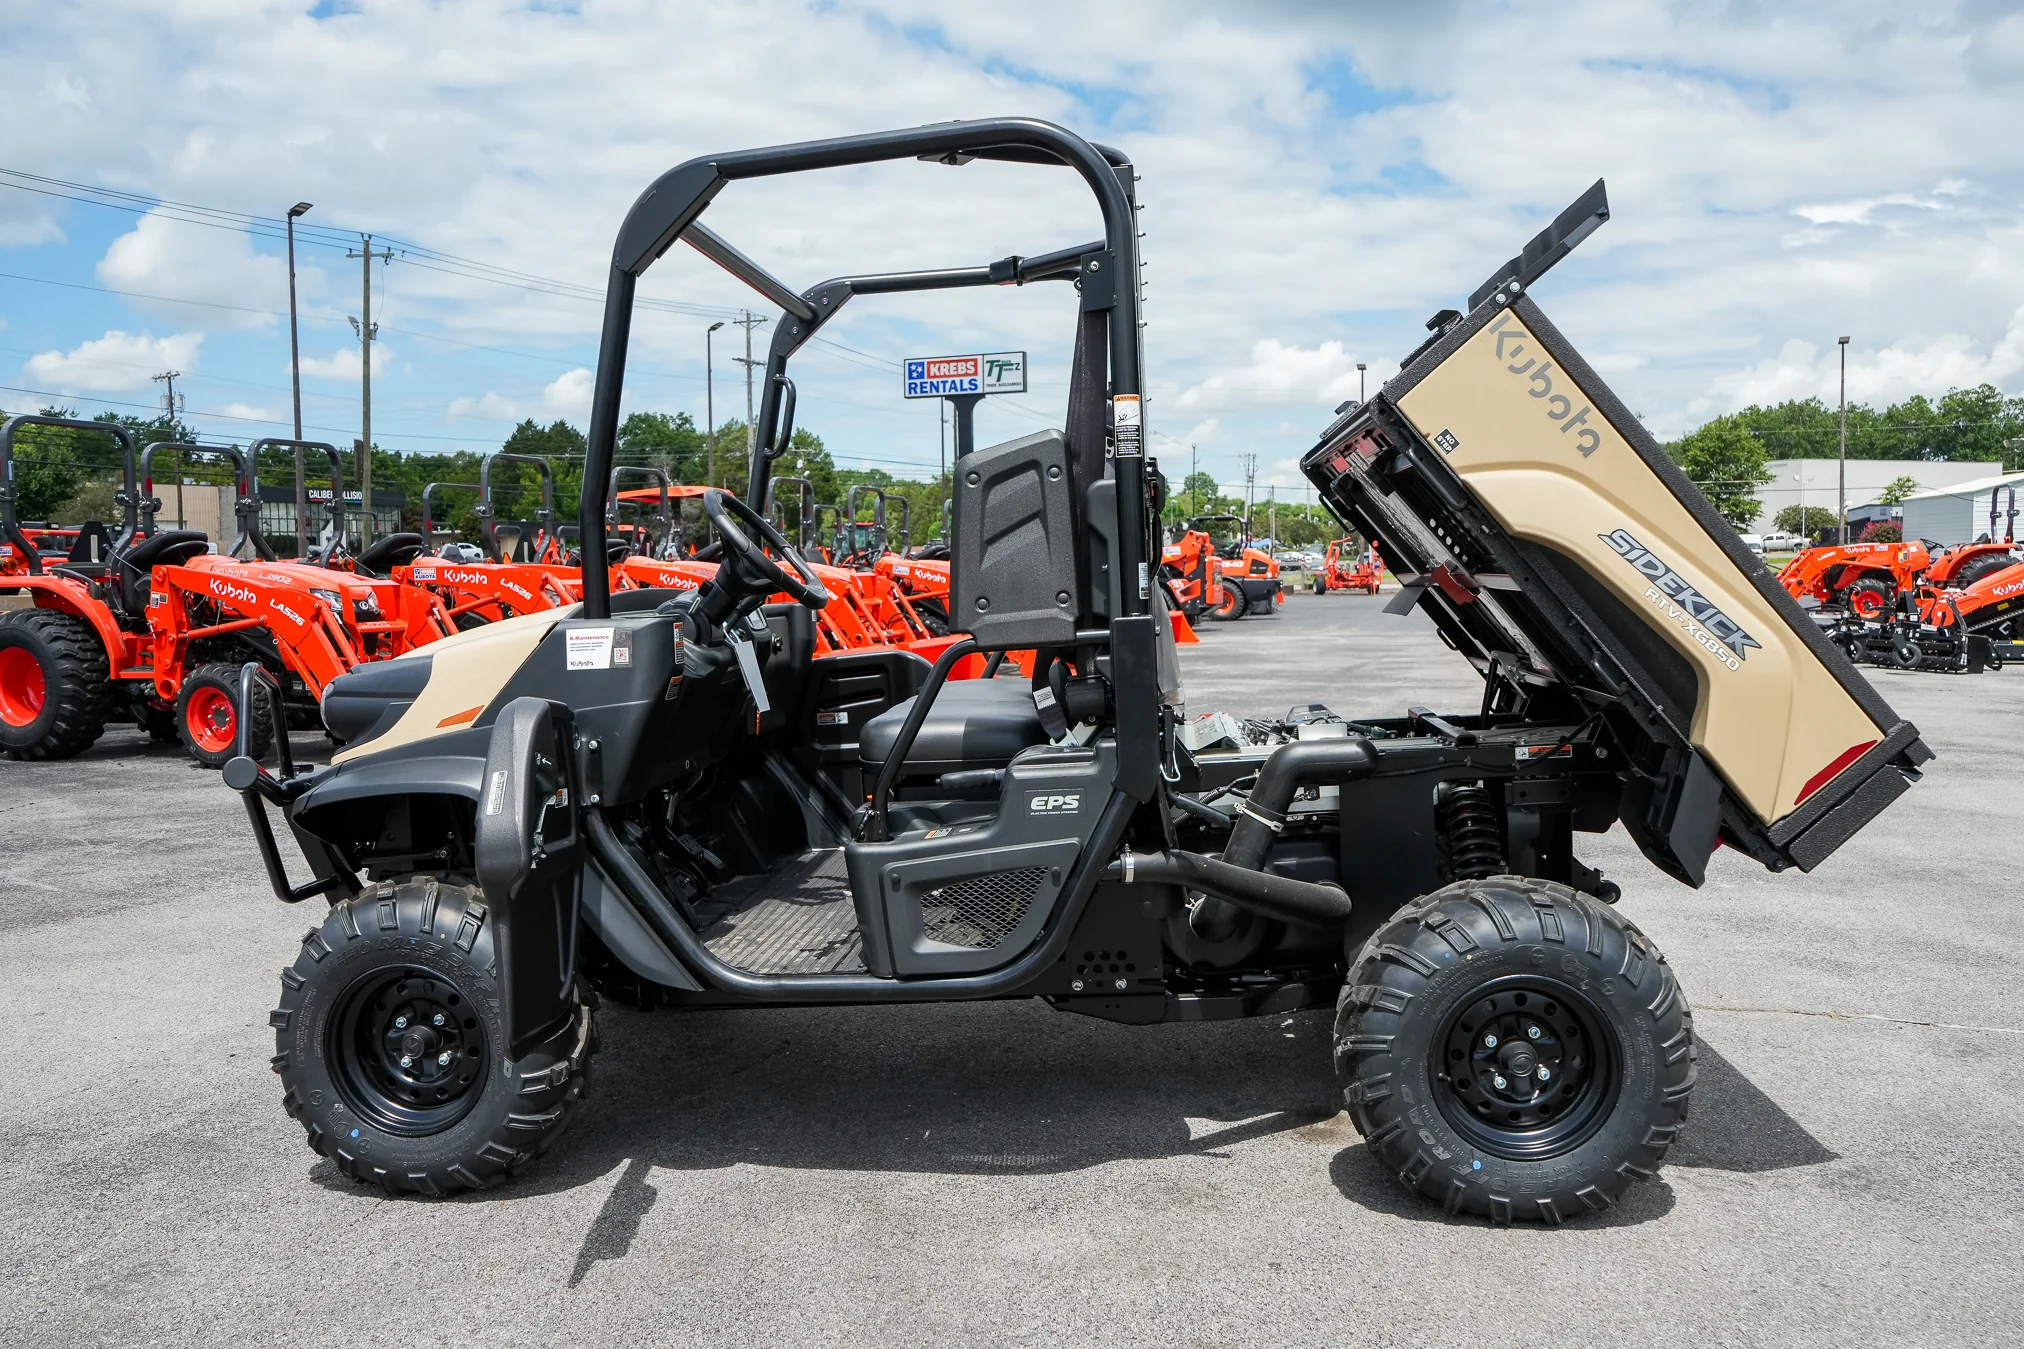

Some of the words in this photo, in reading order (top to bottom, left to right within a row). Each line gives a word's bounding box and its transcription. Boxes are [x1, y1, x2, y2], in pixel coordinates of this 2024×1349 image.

[930, 361, 975, 376] KREBS
[908, 378, 978, 395] RENTALS
[1488, 313, 1600, 458] Kubota
[1437, 435, 1452, 451] STEP
[1445, 434, 1455, 445] NO
[342, 490, 363, 500] LLISIO
[1843, 546, 1870, 554] Kubota
[258, 571, 293, 585] L3902
[659, 572, 699, 590] Kubota
[914, 568, 947, 584] Kubota
[444, 569, 488, 585] Kubota
[500, 577, 533, 601] LA526
[209, 578, 257, 604] Kubota
[269, 598, 306, 626] LA526
[1597, 528, 1762, 661] SIDEKICK
[1644, 587, 1740, 671] RTV-XG850
[1030, 794, 1080, 810] EPS
[379, 935, 443, 956] MAG
[1400, 1084, 1453, 1161] ROAD
[1449, 1163, 1512, 1192] OFF
